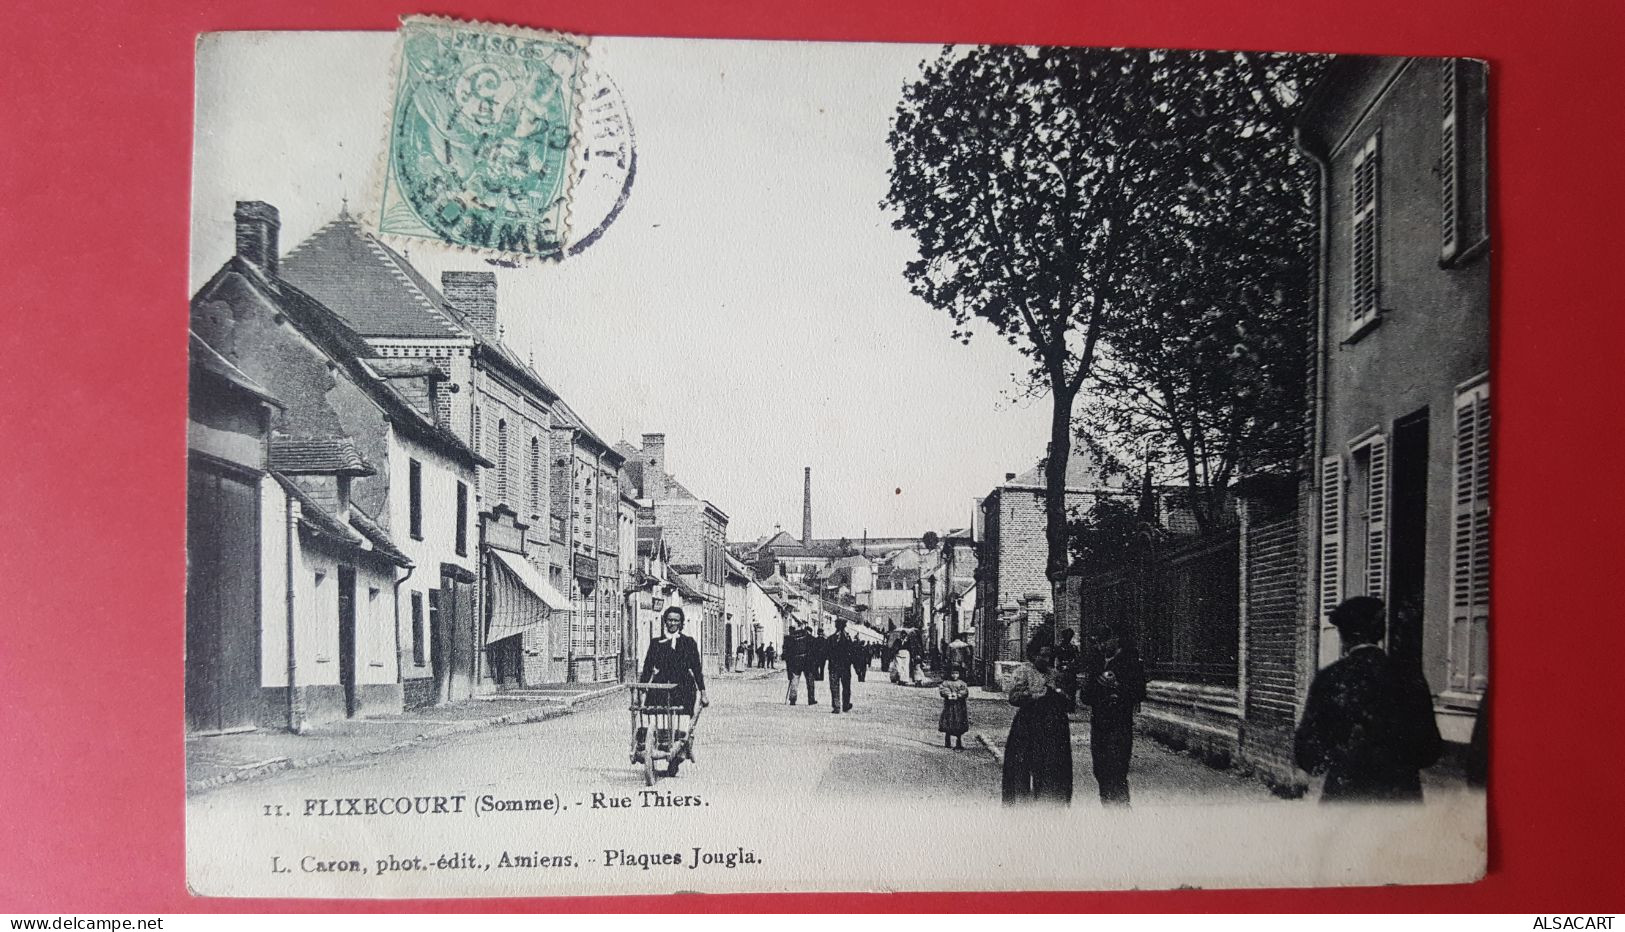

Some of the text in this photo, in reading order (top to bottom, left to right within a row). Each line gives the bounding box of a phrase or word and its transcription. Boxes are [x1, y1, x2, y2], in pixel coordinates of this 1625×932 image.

[303, 795, 467, 816] FLIXECOURT
[474, 793, 569, 818] (Somme).
[590, 792, 632, 810] Rue
[637, 789, 710, 809] Thiers.
[271, 855, 293, 874] L.
[300, 855, 369, 876] Caron,
[375, 852, 491, 876] phot.-édit.,
[497, 850, 579, 870] Amiens.
[603, 849, 683, 871] Plaques
[687, 847, 763, 870] Jougla.
